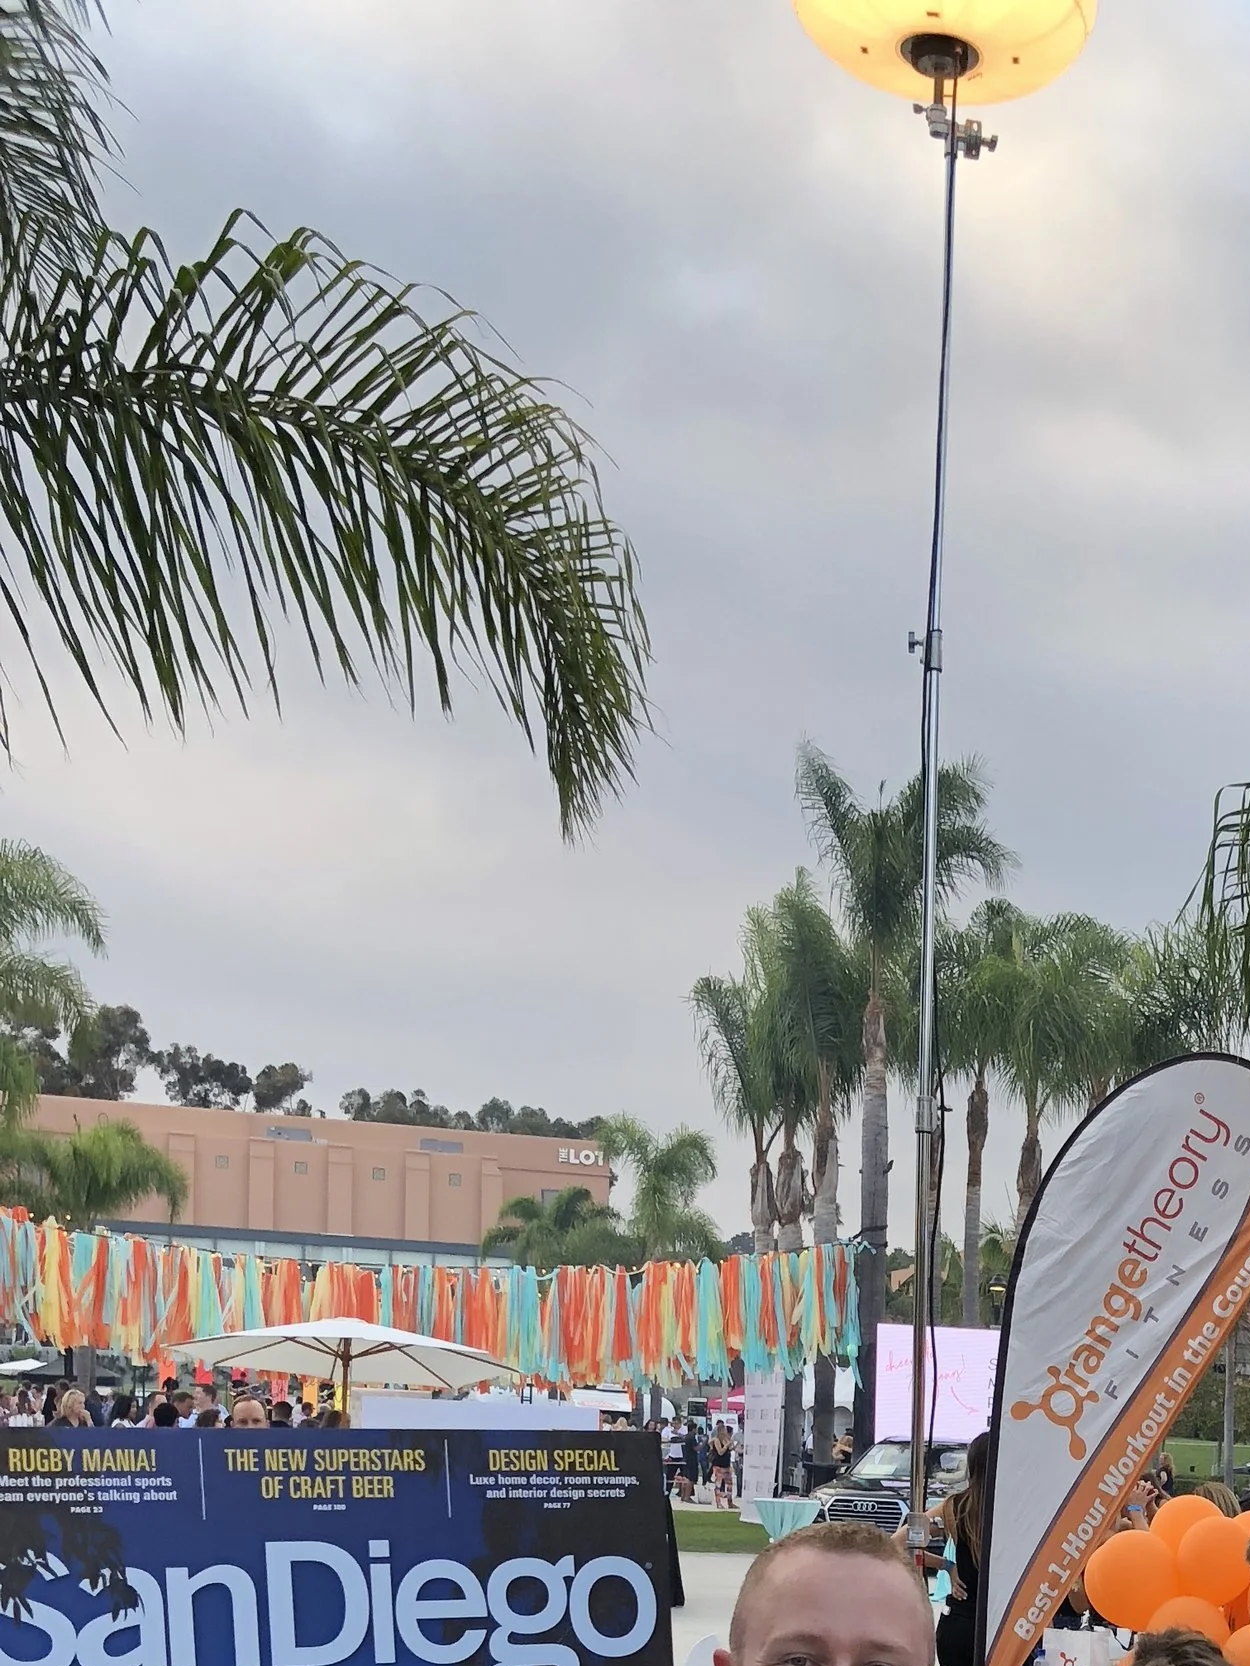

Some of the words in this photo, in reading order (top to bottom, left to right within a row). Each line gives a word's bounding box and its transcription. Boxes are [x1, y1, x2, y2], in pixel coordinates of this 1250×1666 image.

[8, 1448, 76, 1473] RUGBY
[82, 1448, 157, 1473] MANIA!
[224, 1449, 260, 1472] THE
[264, 1449, 308, 1472] NEW
[313, 1449, 426, 1472] SUPERSTARS
[488, 1449, 549, 1472] DESIGN
[553, 1449, 621, 1472] SPECIAL
[31, 1475, 52, 1487] the
[55, 1474, 132, 1490] professional
[134, 1475, 173, 1489] sports
[261, 1476, 284, 1499] OF
[289, 1476, 347, 1499] CRAFT
[352, 1476, 395, 1499] BEER
[469, 1474, 496, 1486] Luxe
[498, 1474, 528, 1486] home
[530, 1474, 562, 1487] decor,
[564, 1475, 591, 1486] room
[593, 1475, 640, 1488] revamps,
[1012, 1583, 1056, 1642] Best
[1048, 1499, 1106, 1584] 1-Hour
[1098, 1386, 1174, 1500] Workout
[1163, 1363, 1193, 1396] in
[1182, 1321, 1221, 1366] the
[0, 1492, 24, 1502] eam
[26, 1489, 96, 1504] everyone's
[97, 1489, 141, 1504] talking
[143, 1489, 178, 1502] about
[486, 1487, 506, 1499] and
[508, 1487, 548, 1499] interior
[550, 1487, 585, 1501] design
[587, 1488, 626, 1499] secrets
